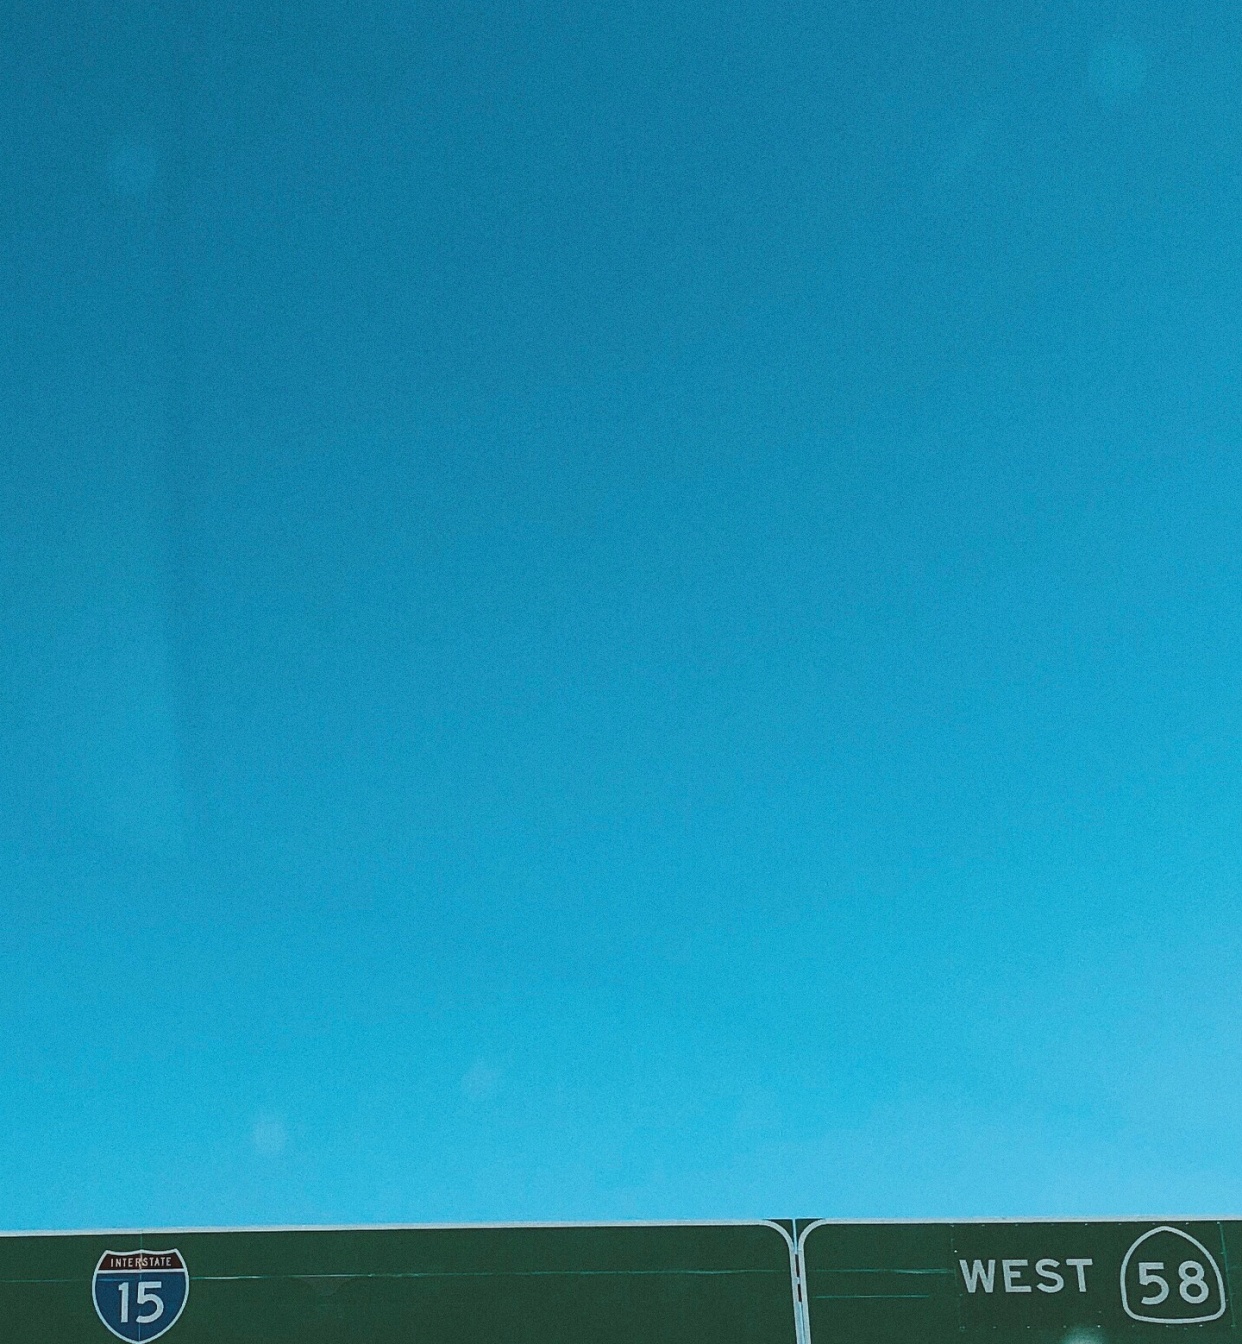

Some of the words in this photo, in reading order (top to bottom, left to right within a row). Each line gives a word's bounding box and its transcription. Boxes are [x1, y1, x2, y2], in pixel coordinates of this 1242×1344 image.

[110, 1256, 172, 1268] INTERSTATE
[959, 1258, 1093, 1293] WEST
[1138, 1260, 1210, 1305] 58
[117, 1281, 165, 1324] 15
